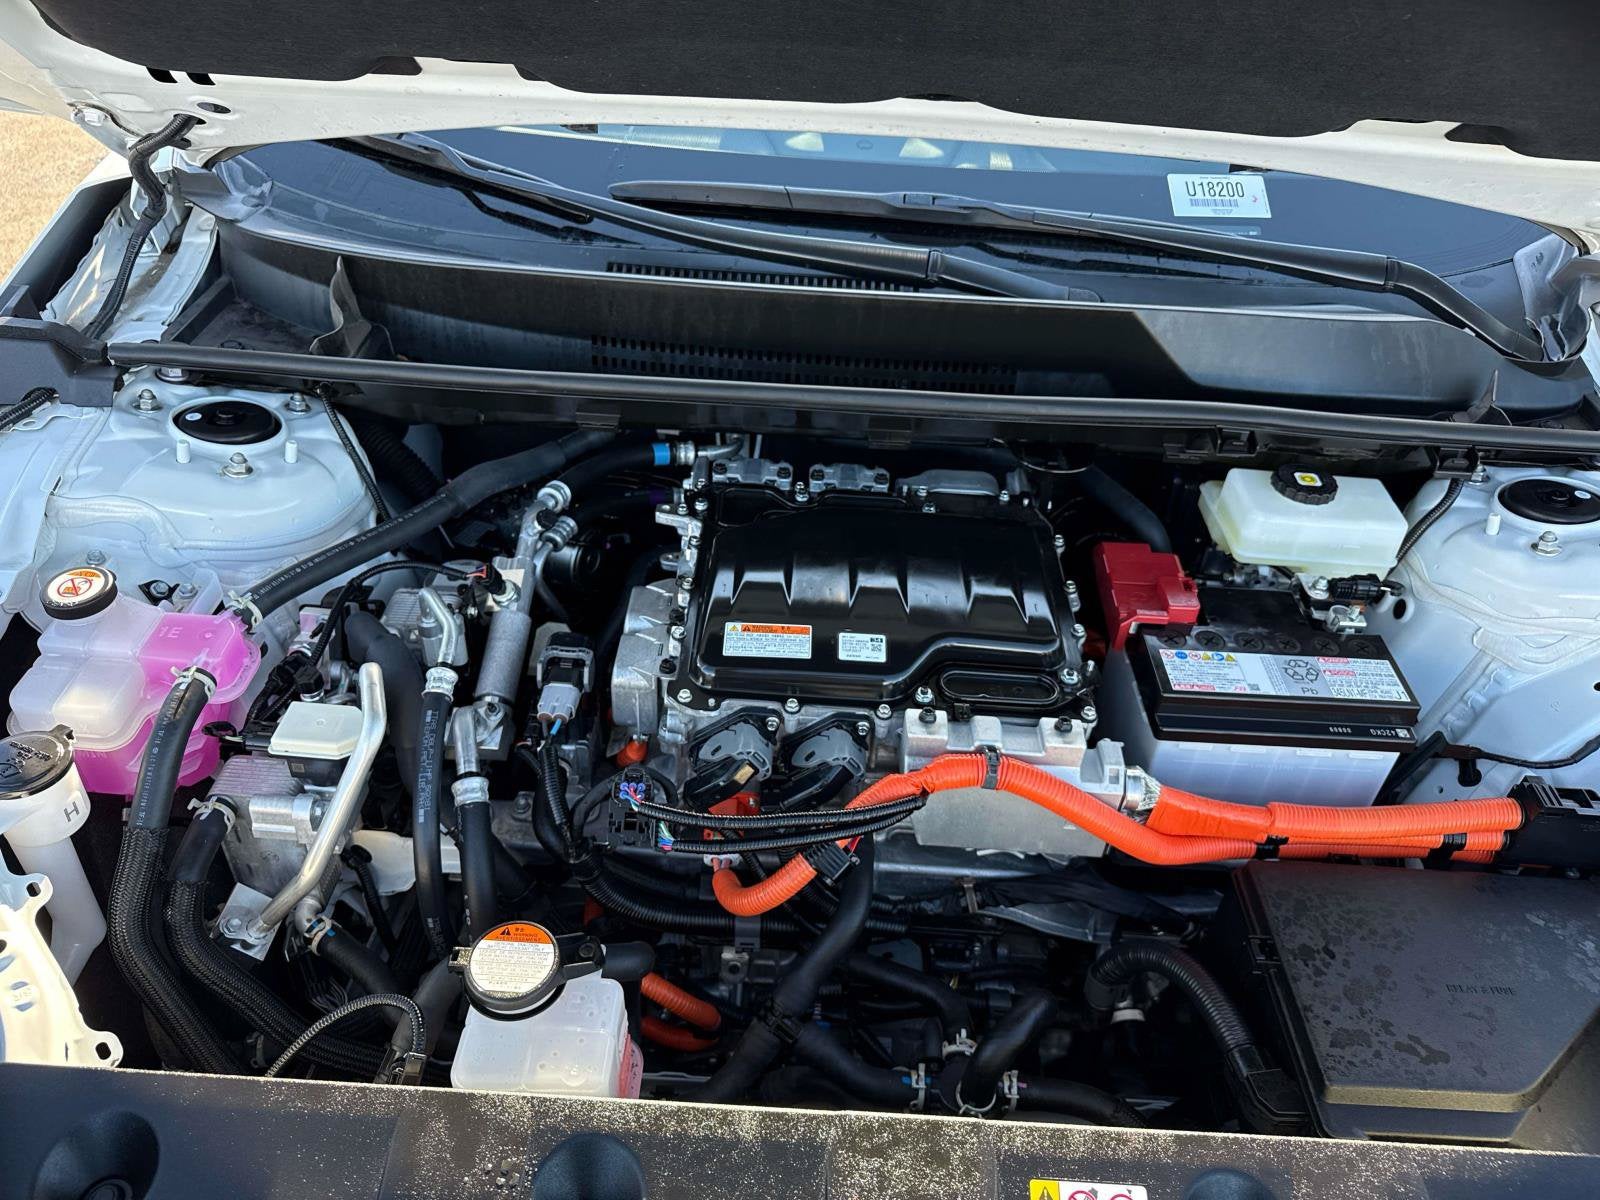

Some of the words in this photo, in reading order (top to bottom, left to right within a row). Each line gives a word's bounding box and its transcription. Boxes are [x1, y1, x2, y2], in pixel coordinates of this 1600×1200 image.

[1185, 181, 1245, 198] U18200
[1301, 686, 1319, 695] Pb
[64, 801, 80, 822] H
